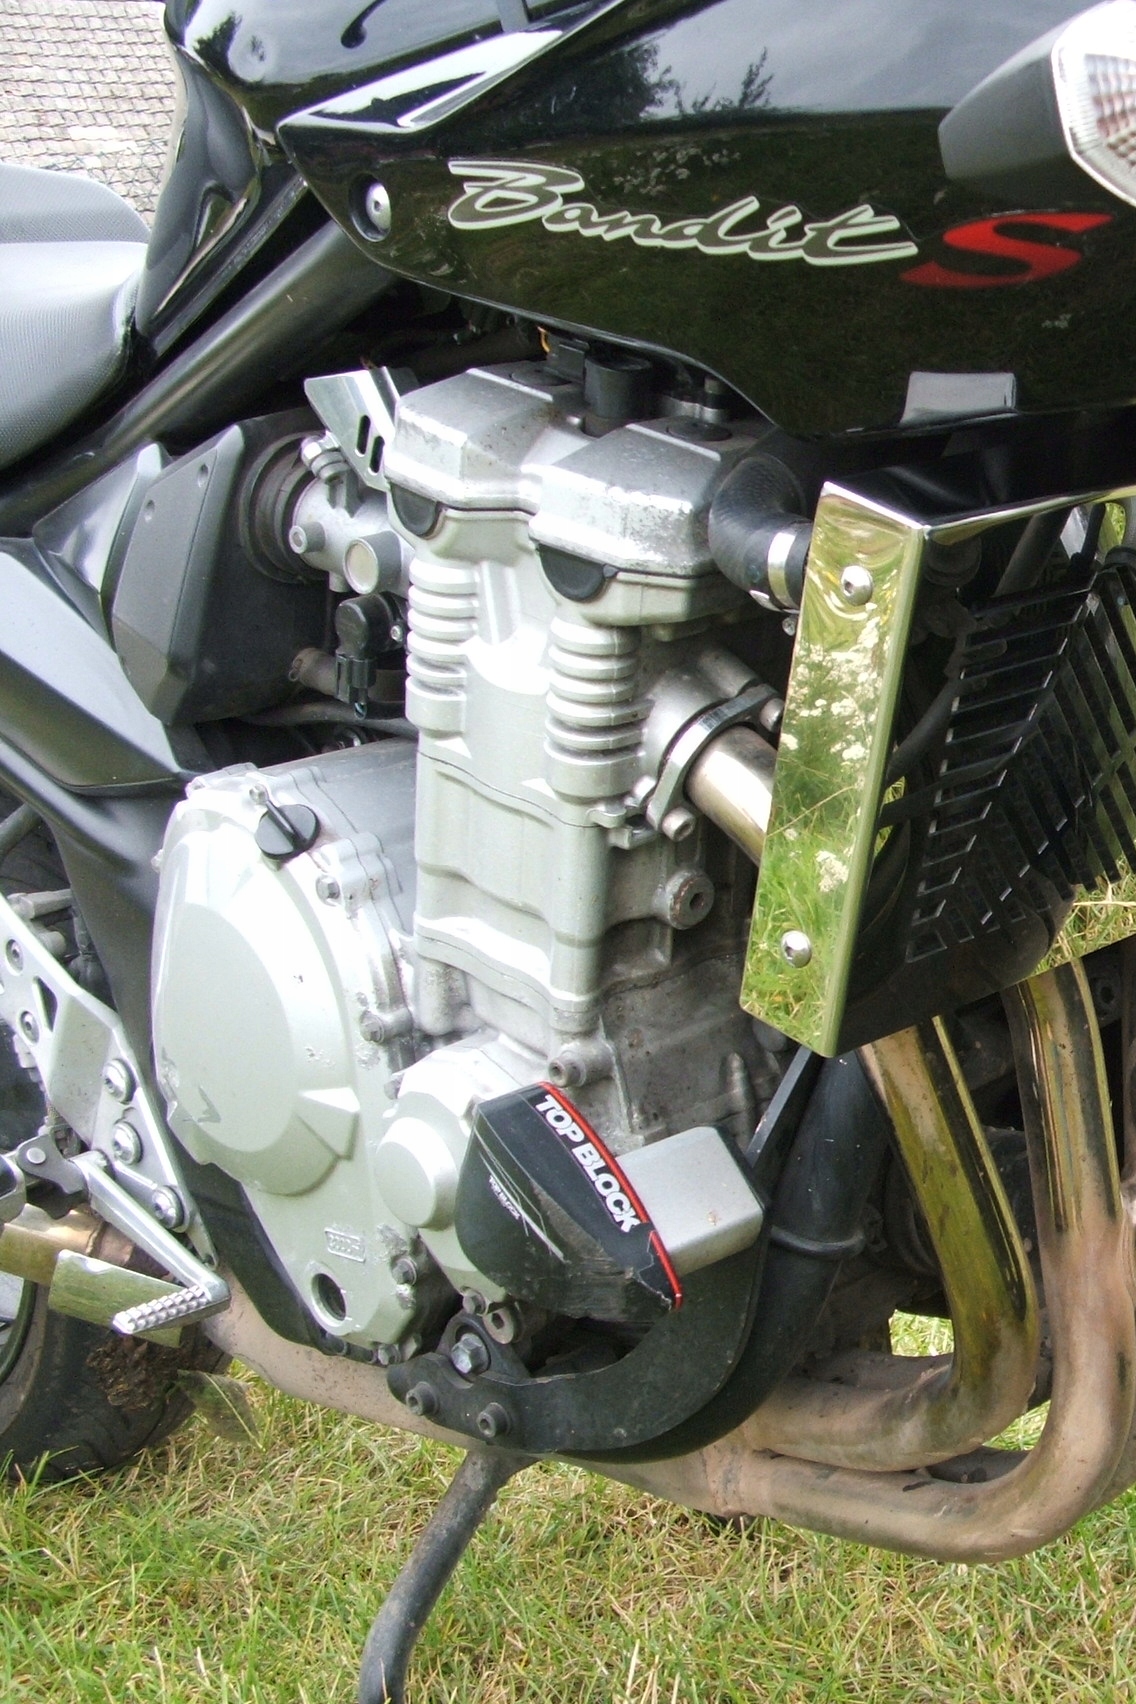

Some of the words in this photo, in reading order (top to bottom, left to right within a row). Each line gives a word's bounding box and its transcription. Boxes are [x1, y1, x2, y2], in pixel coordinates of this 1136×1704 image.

[448, 159, 918, 266] Bandit
[902, 211, 1112, 286] S
[535, 1094, 584, 1143] TOP
[572, 1142, 641, 1233] BLOCK
